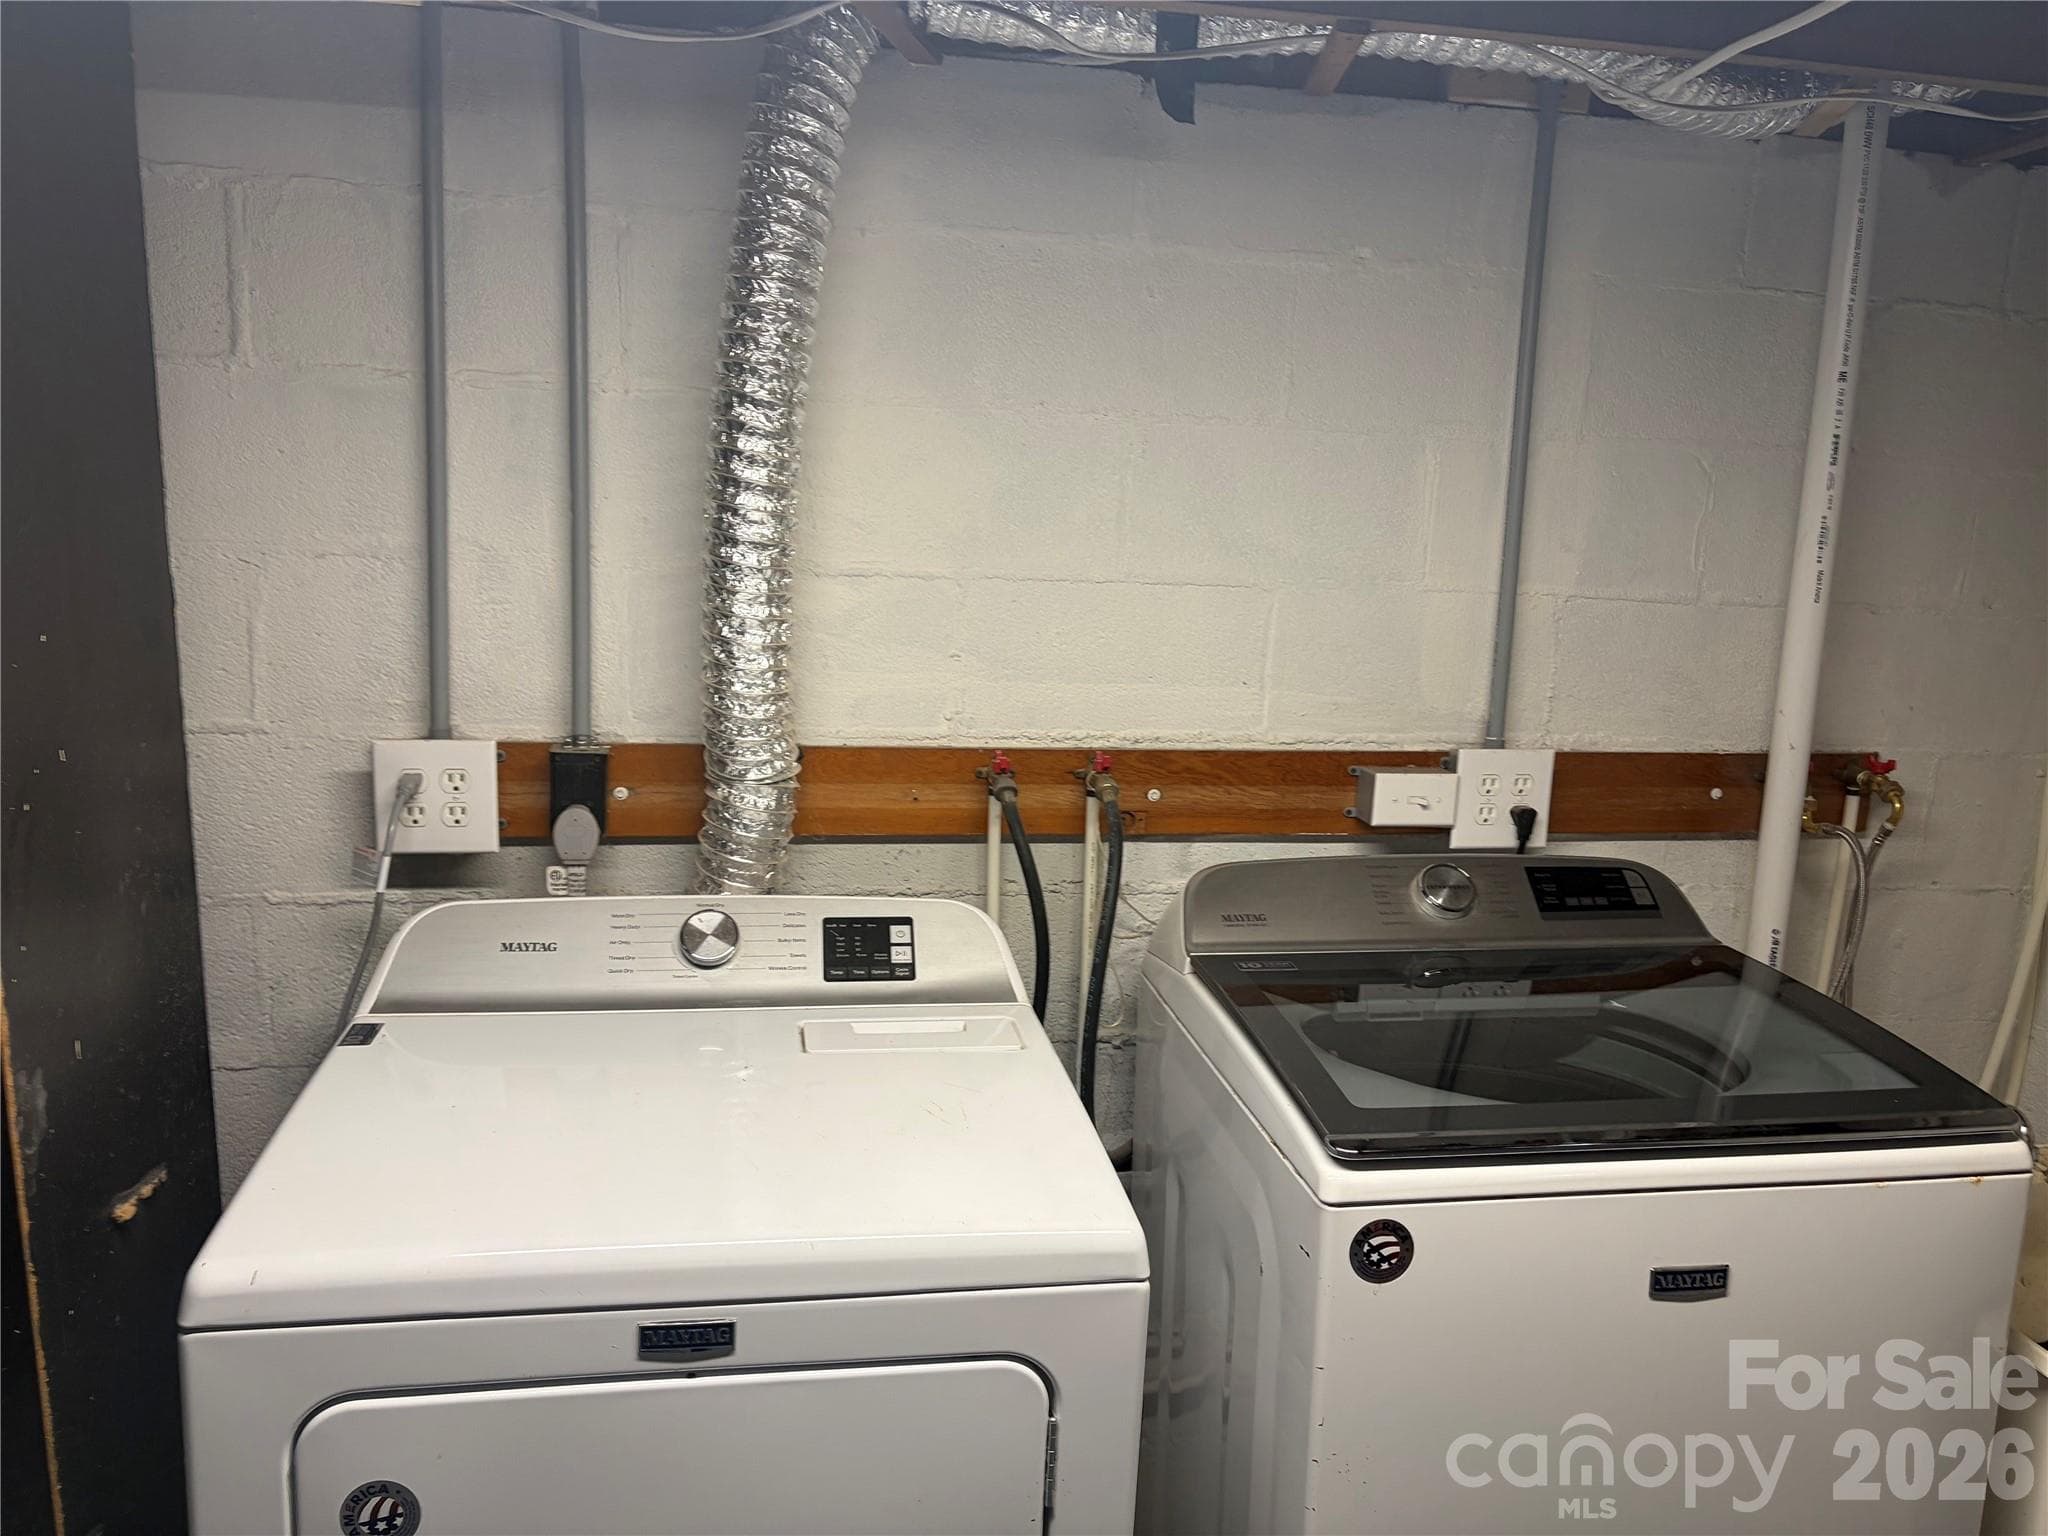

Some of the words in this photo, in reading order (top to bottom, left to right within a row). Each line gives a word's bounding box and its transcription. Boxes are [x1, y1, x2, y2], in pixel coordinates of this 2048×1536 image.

[1221, 913, 1267, 922] MAYTAG
[500, 942, 558, 952] MAYTAG
[1655, 1272, 1725, 1289] MAYTAG
[642, 1327, 731, 1346] MAYTAG
